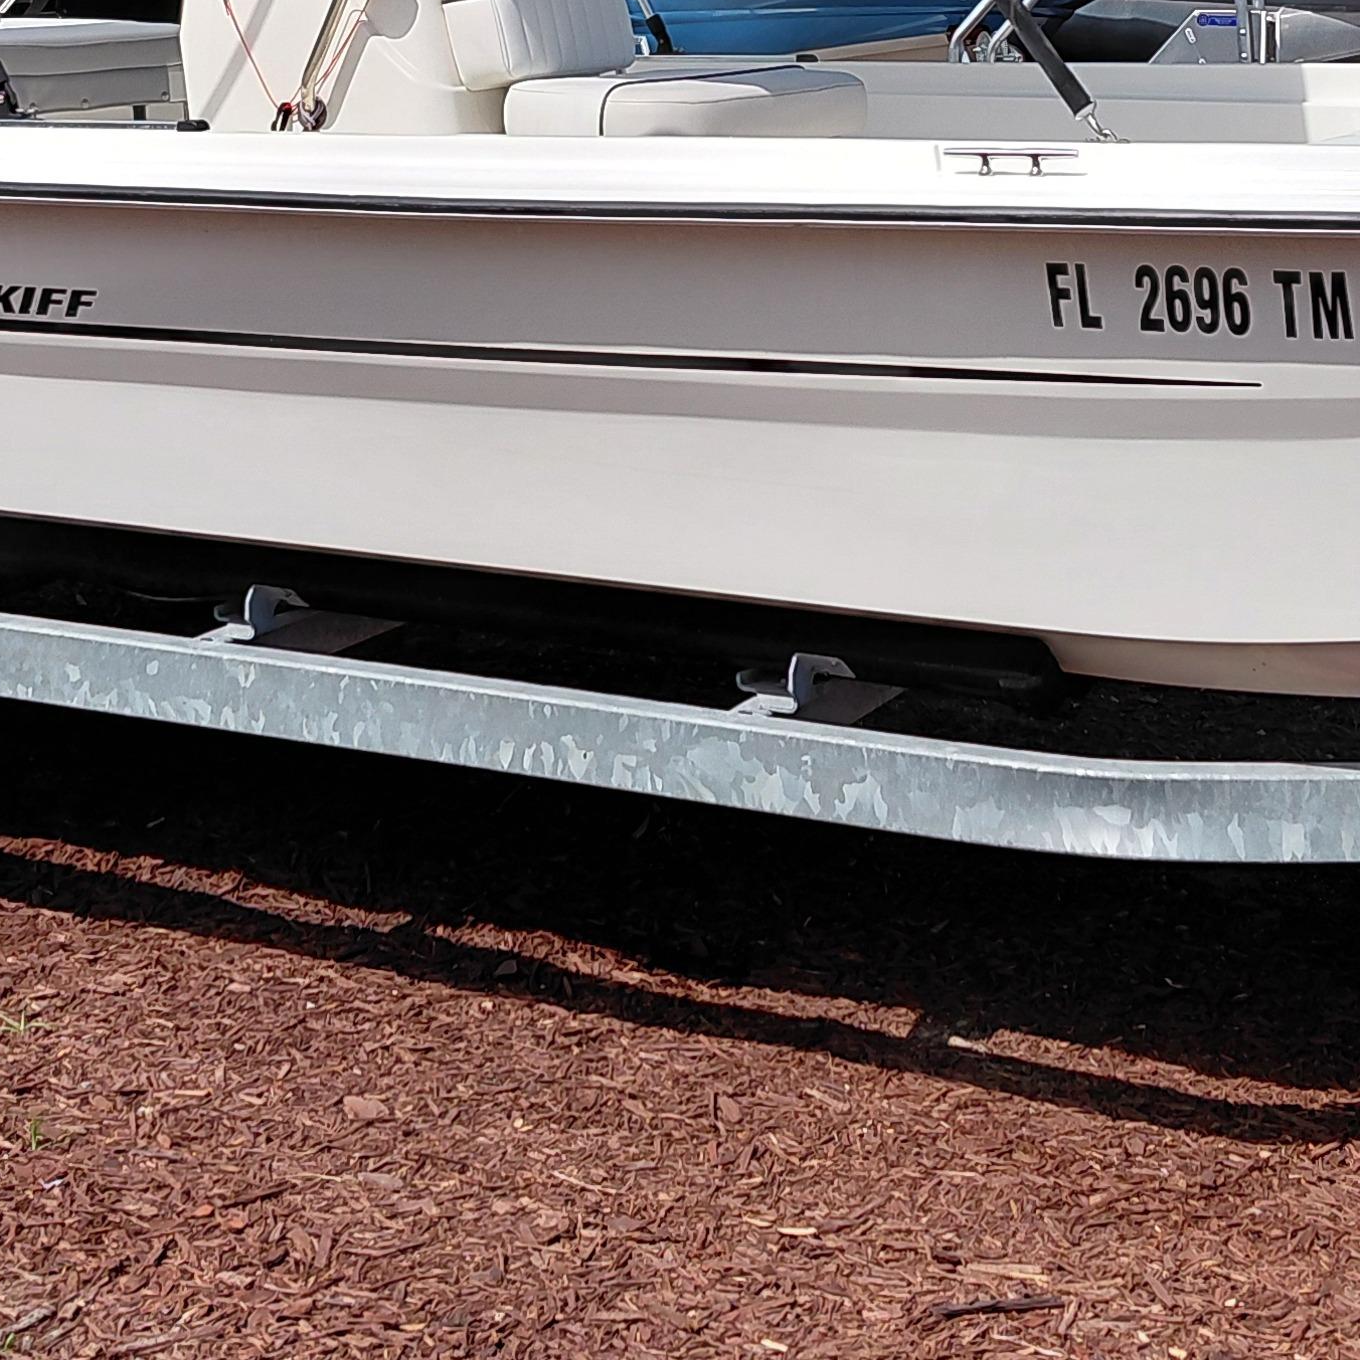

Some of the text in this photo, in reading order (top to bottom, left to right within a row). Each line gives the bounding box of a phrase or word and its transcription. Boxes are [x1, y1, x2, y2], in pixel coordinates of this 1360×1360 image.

[1045, 262, 1355, 340] FL 2696 TM
